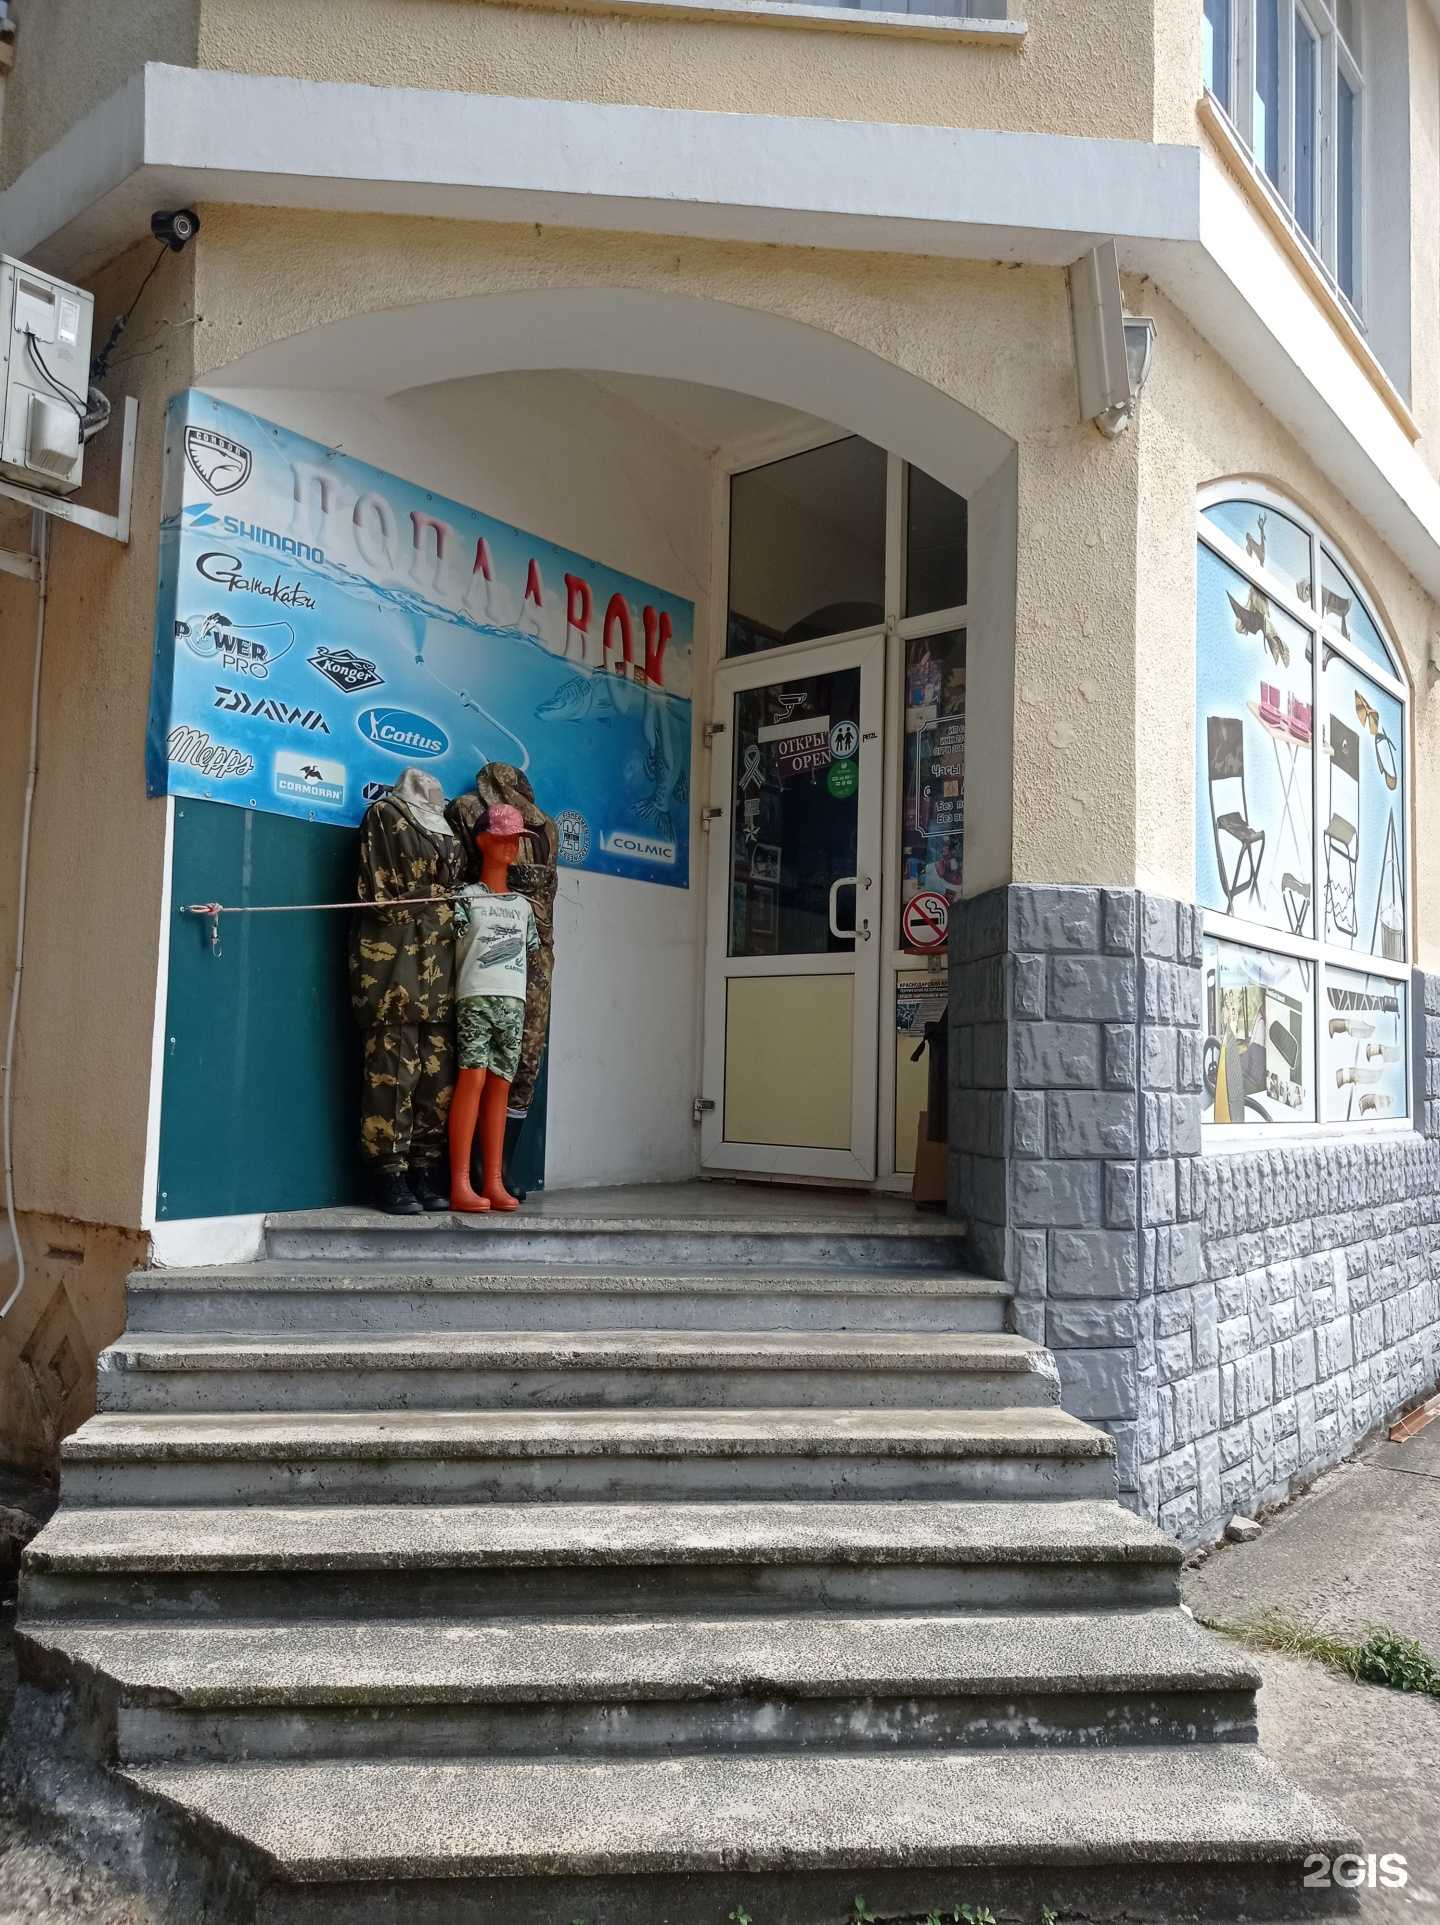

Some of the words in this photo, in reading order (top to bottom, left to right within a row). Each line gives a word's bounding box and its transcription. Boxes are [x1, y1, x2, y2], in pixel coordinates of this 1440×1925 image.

[223, 515, 326, 565] SHIMANO
[196, 552, 317, 610] Gamakatsu
[223, 654, 269, 679] PRO
[323, 659, 373, 684] Konger
[213, 685, 331, 735] DAIWA
[380, 724, 443, 752] Cottus
[166, 725, 255, 779] Mepps
[792, 750, 832, 771] OPEN
[278, 779, 342, 801] CORMORAN
[613, 837, 673, 859] COLMIC
